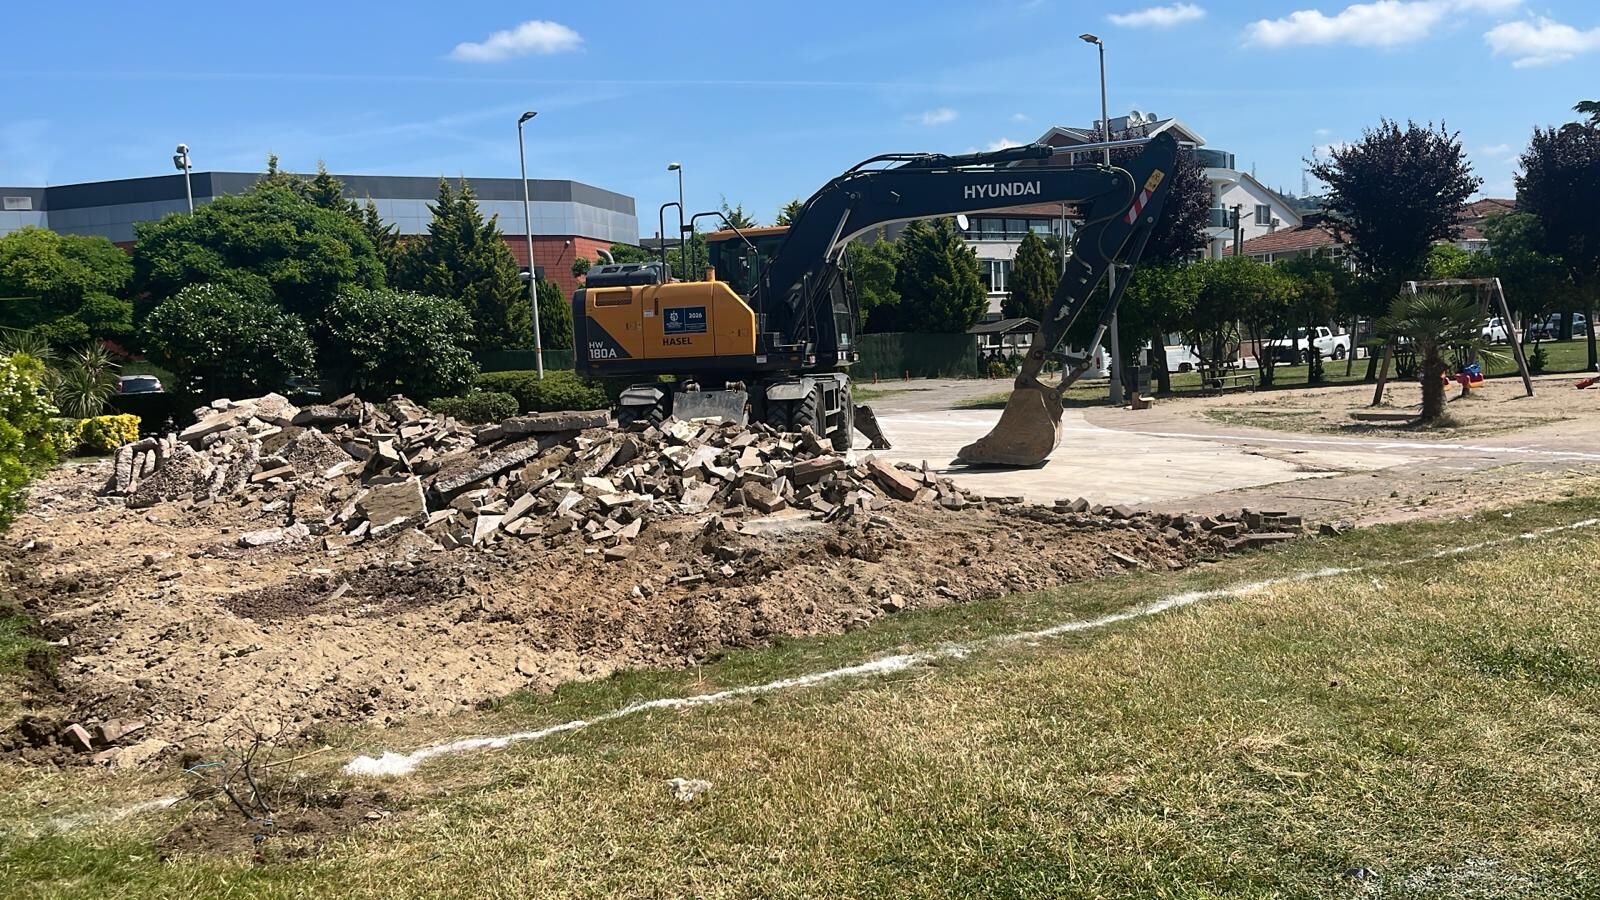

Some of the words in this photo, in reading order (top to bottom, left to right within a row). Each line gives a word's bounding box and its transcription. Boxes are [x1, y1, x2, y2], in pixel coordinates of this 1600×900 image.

[964, 180, 1041, 199] HYUNDAI
[588, 341, 604, 349] HW
[662, 337, 693, 346] HASEL
[589, 348, 617, 359] 180A
